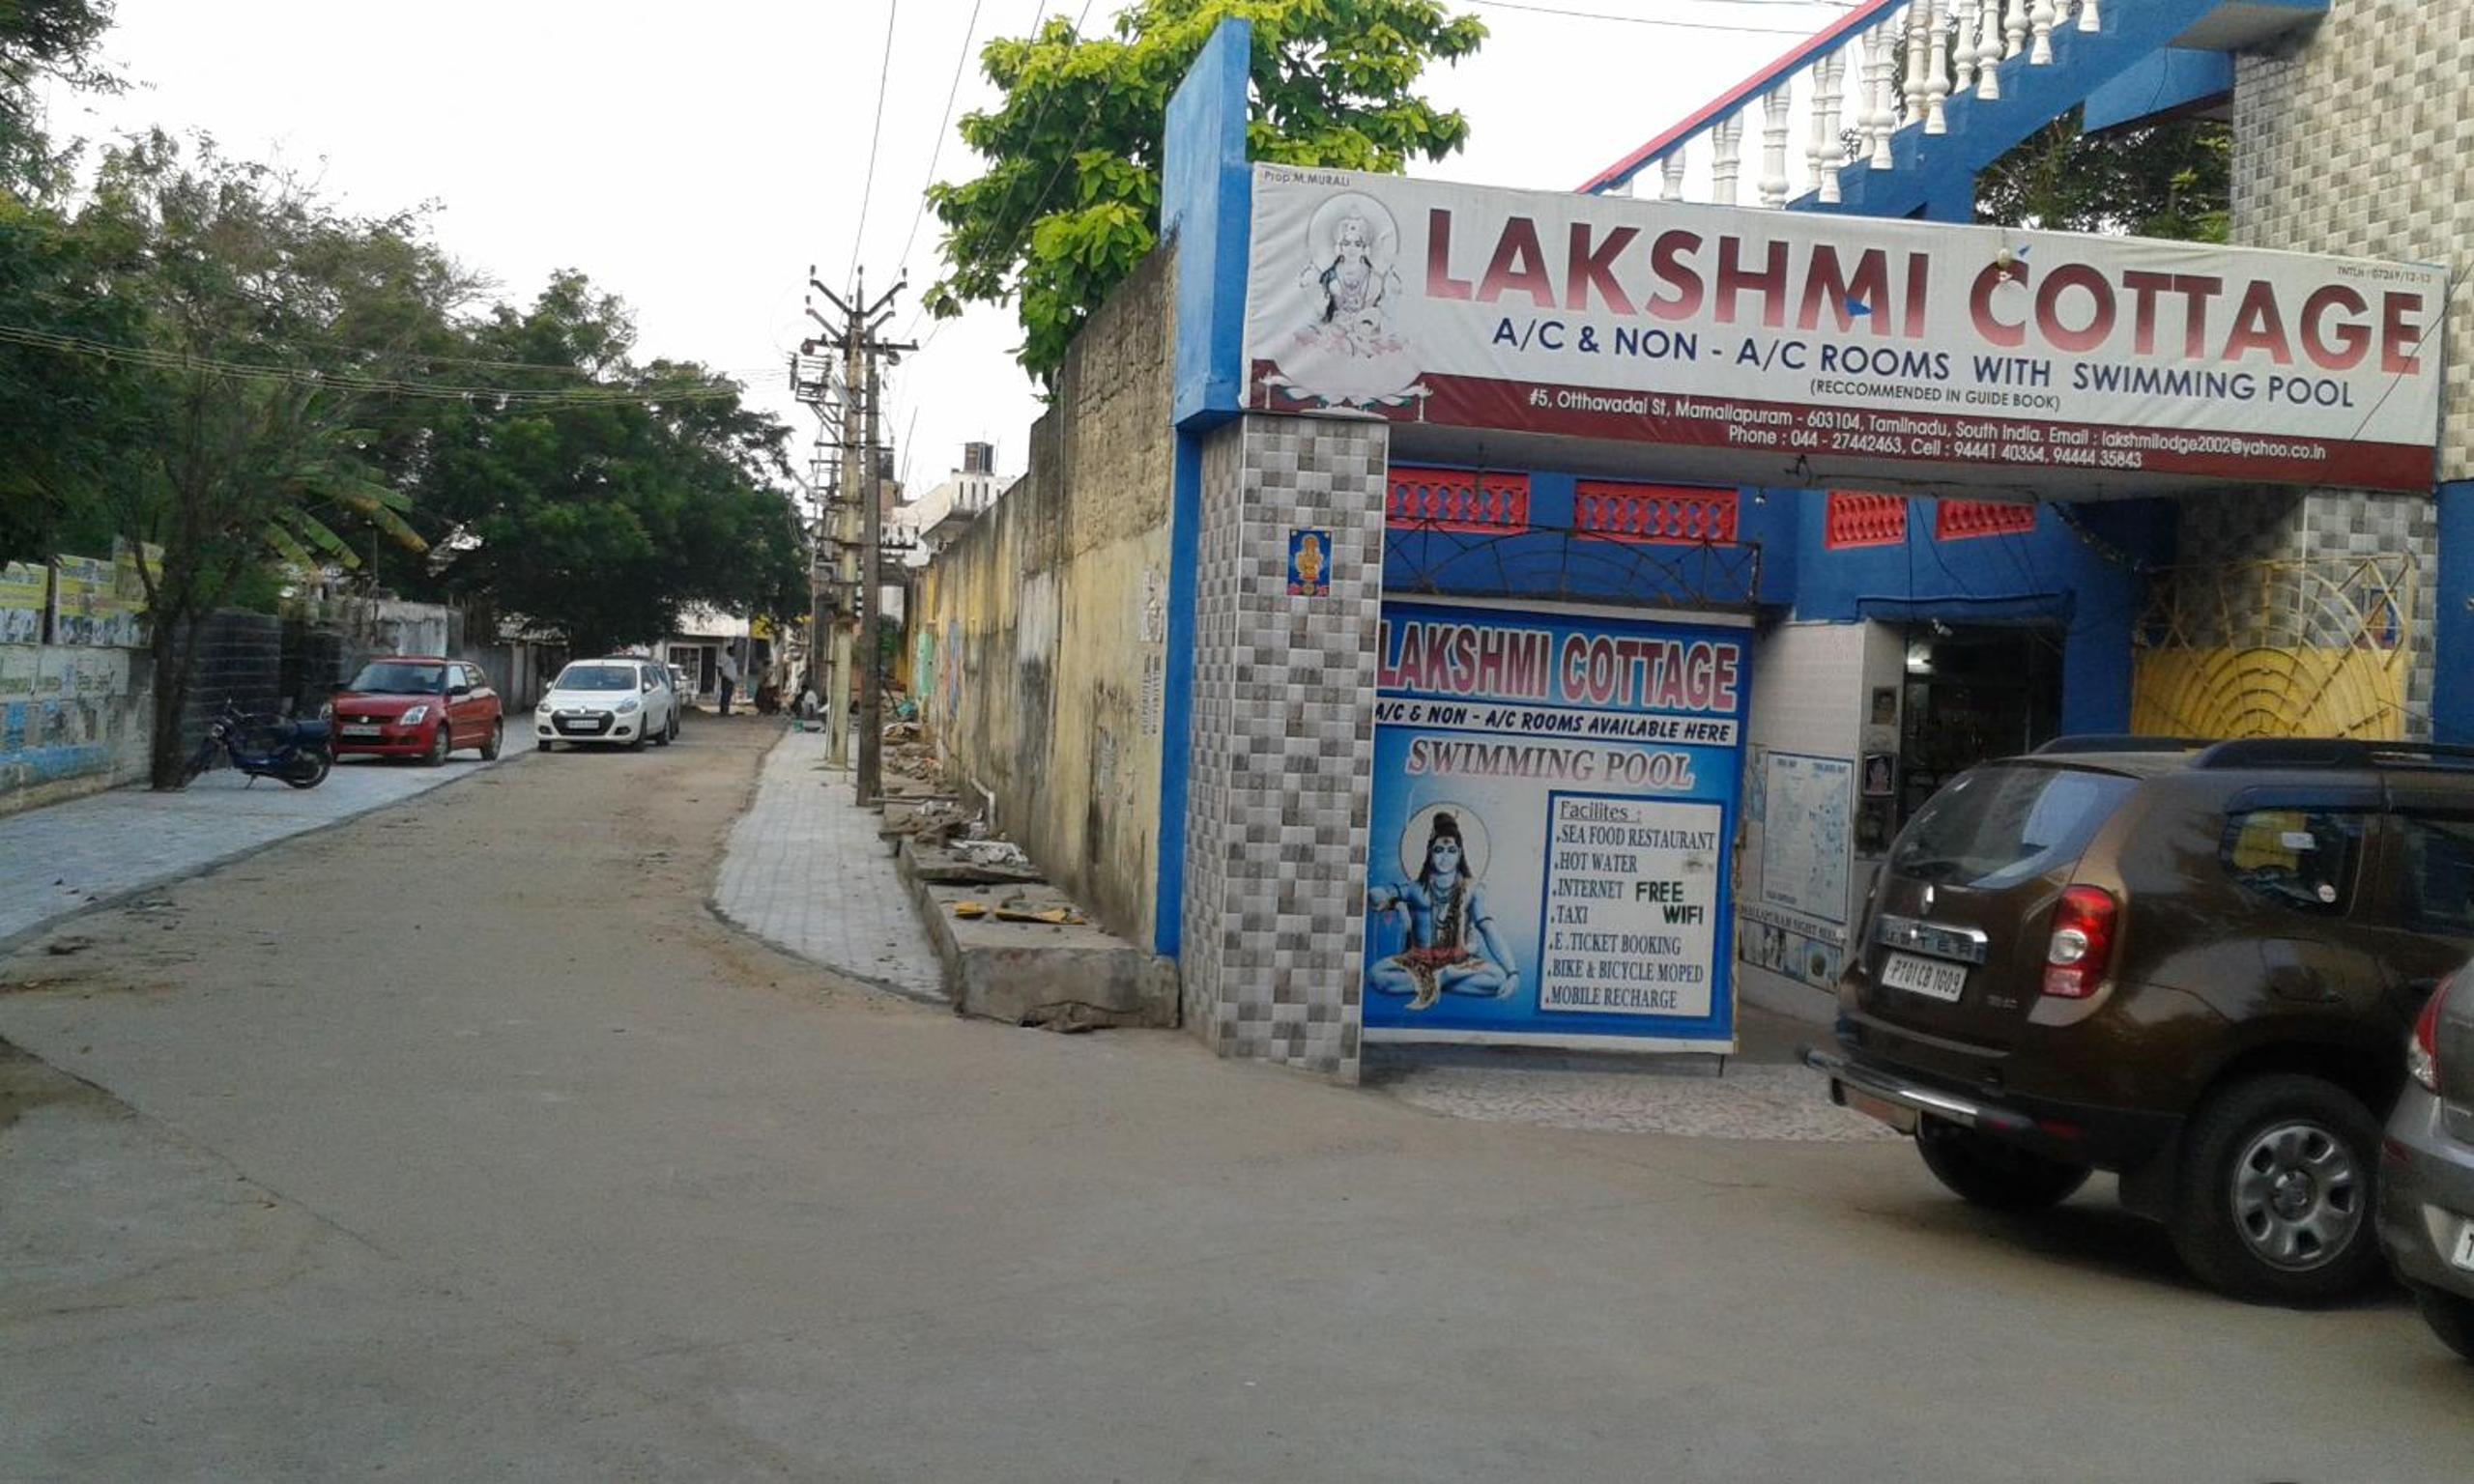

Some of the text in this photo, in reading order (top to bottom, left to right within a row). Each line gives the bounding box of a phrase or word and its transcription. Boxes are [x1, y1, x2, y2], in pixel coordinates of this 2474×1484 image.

[1425, 208, 2424, 376] LAKSHMI COTTAGE
[1492, 318, 1565, 351] A/C
[1578, 326, 1600, 354] &
[1615, 328, 1697, 360] NON
[1736, 338, 1807, 372] A/C
[1822, 343, 1950, 381] ROOMS
[1973, 355, 2052, 388] WITH
[2073, 362, 2256, 400] SWIMMING
[2268, 376, 2354, 409] POOL
[1810, 378, 2060, 414] (RECCOMMENDED IN GUIDE BOOK)
[1557, 390, 1648, 415] Otthavadai
[1675, 400, 1793, 427] Mamallapuram
[1955, 420, 1999, 441] South
[2049, 426, 2089, 444] Email
[1729, 425, 1777, 444] Phone
[1791, 429, 1818, 447] 044
[1911, 439, 1941, 456] Cell
[1954, 441, 1996, 459] 94441
[2053, 448, 2095, 467] 94444
[1376, 621, 1739, 712] LAKSHMI COTTAGE
[1375, 703, 1403, 722] A/C
[1409, 705, 1422, 722] &
[1429, 706, 1467, 726] NON
[1484, 709, 1515, 728] A/C
[1520, 711, 1584, 732] ROOMS
[1588, 717, 1680, 739] AVAILABLE
[1684, 723, 1731, 742] HERE
[1407, 737, 1695, 788] SWIMMING POOL
[1560, 801, 1629, 821] Facilites
[1590, 827, 1625, 846] FOOD
[1627, 829, 1716, 850] RESTAURANT
[1592, 854, 1638, 873] WATER
[1636, 881, 1684, 902] FREE
[1662, 905, 1704, 925] WIFI
[1621, 935, 1683, 956] BOOKING
[1586, 961, 1596, 979] &
[1598, 960, 1654, 981] BICYCLE
[1656, 963, 1705, 984] MOPED
[1603, 987, 1678, 1010] RECHARGE
